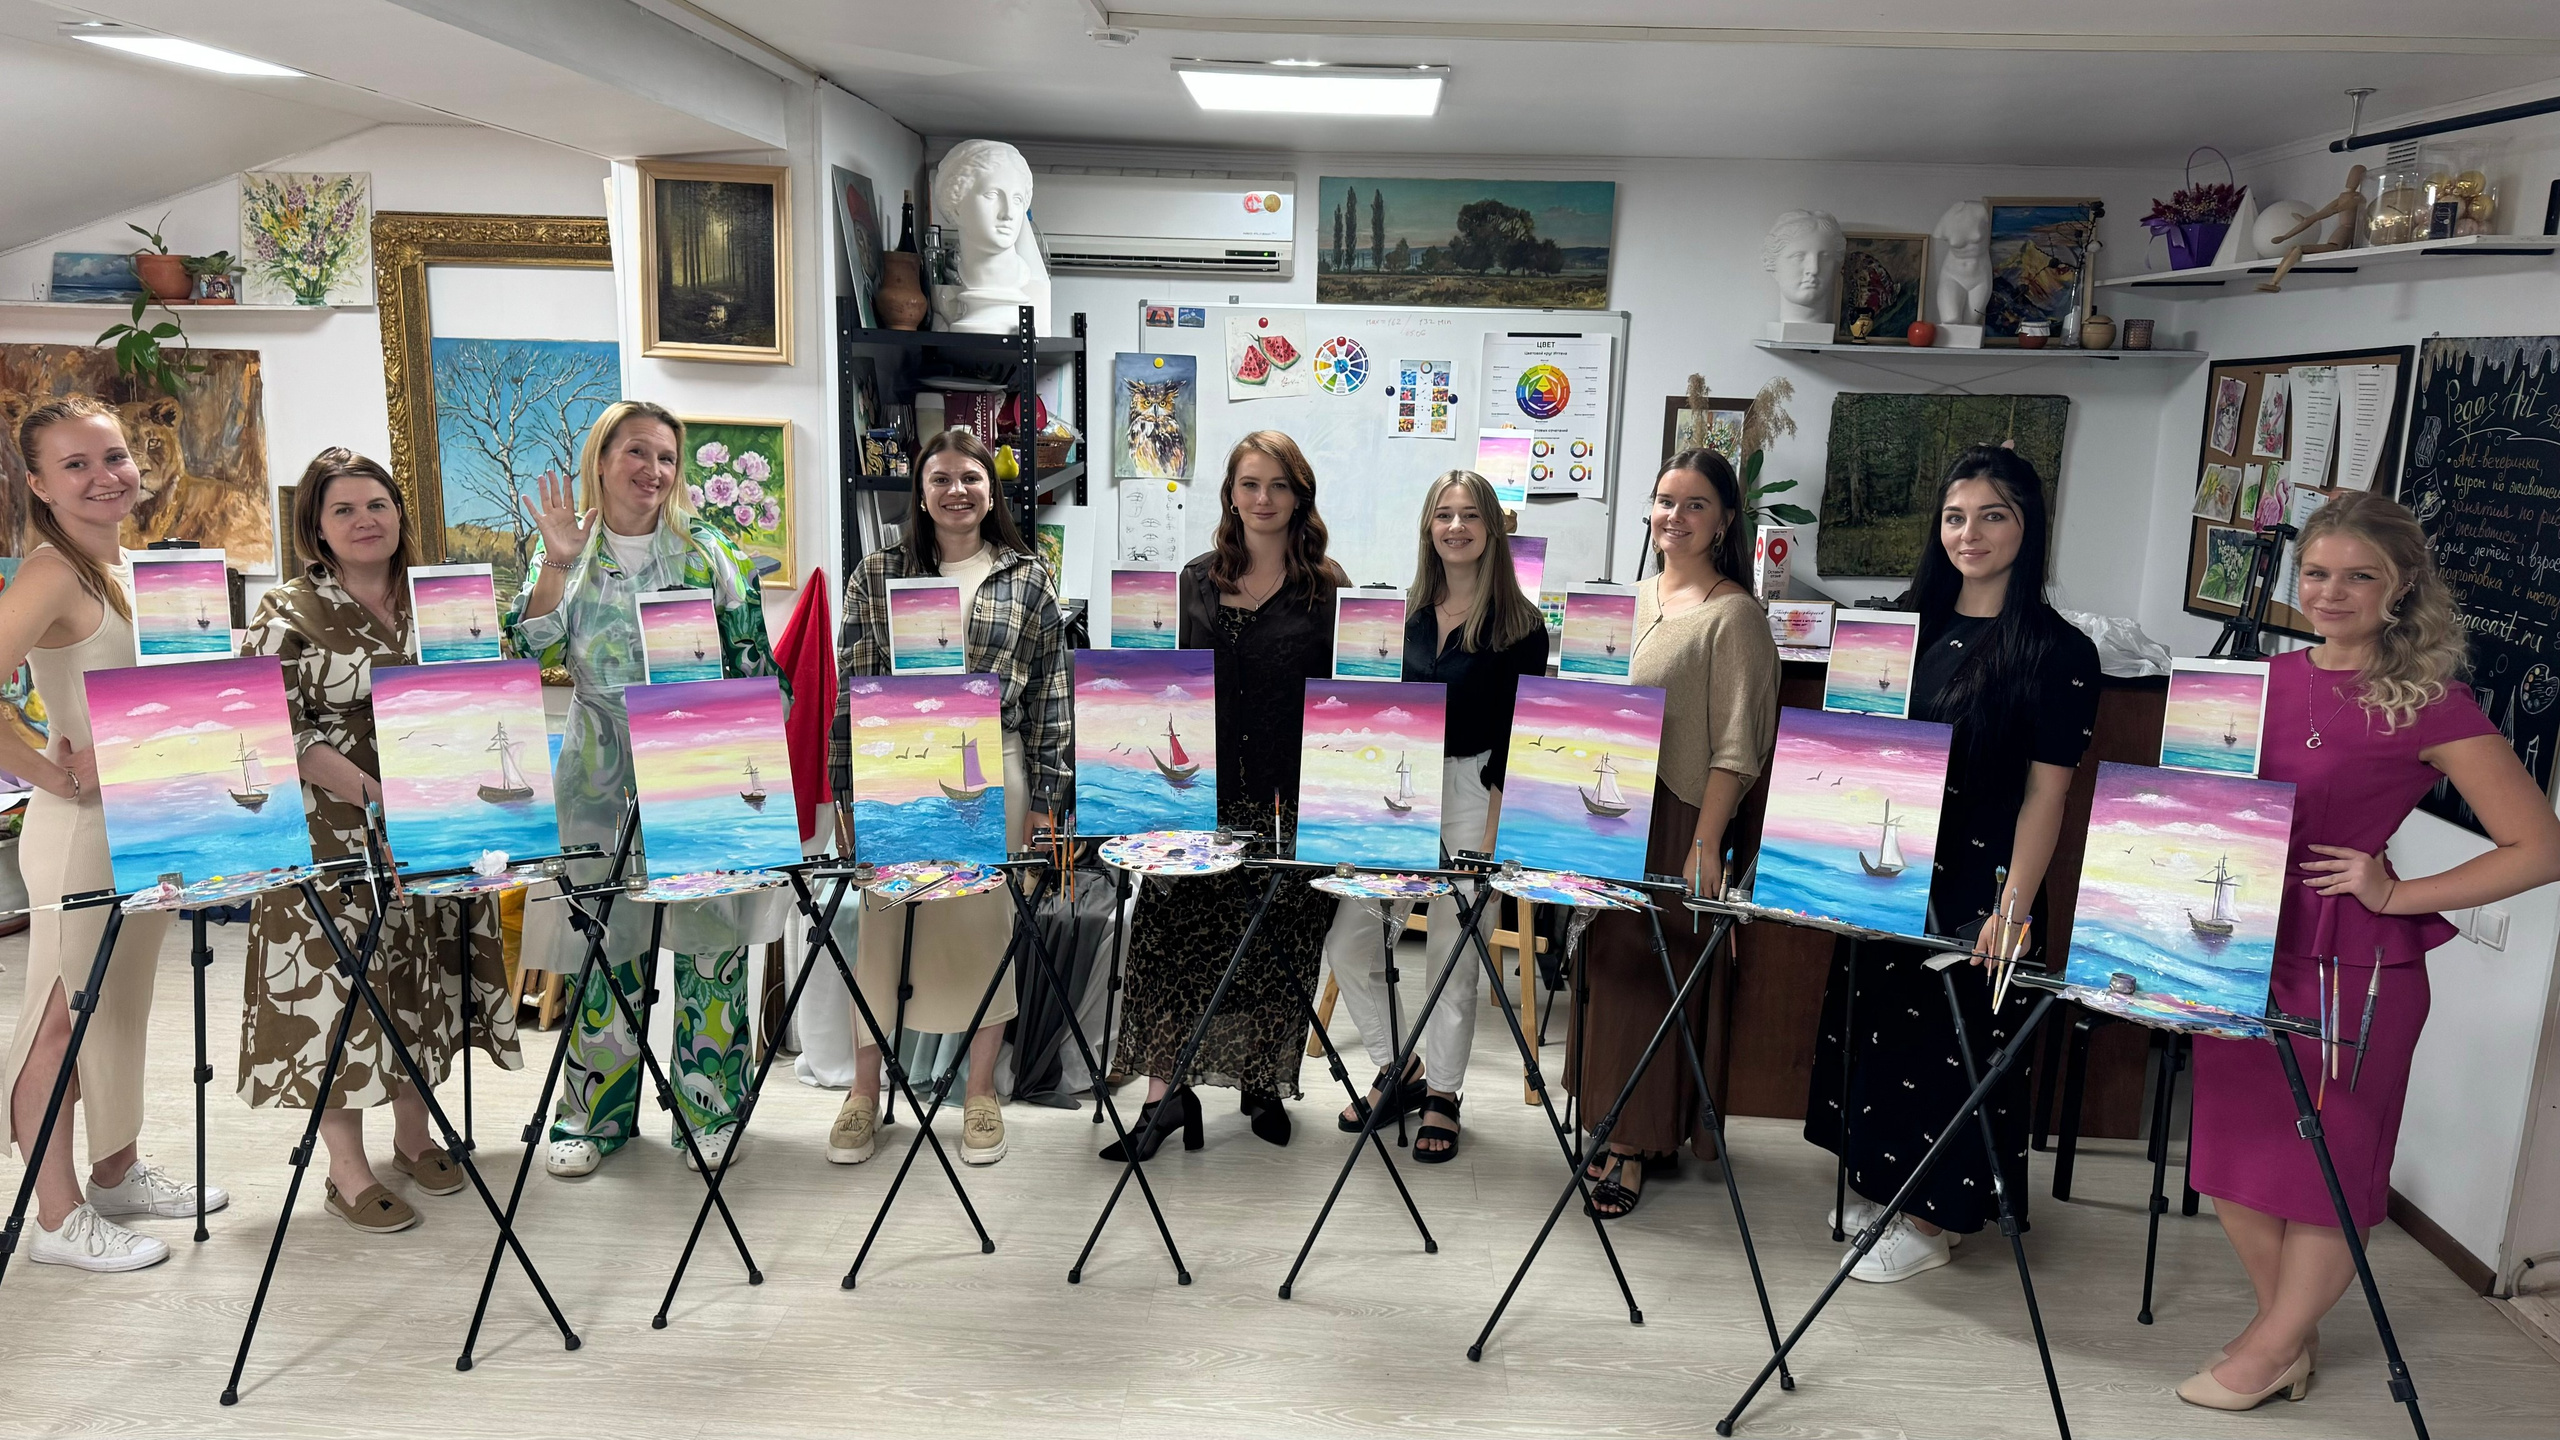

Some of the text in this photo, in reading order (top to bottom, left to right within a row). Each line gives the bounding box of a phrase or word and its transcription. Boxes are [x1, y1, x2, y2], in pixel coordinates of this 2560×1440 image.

[1536, 341, 1556, 349] ЦВЕТ
[2445, 378, 2499, 444] Pegas
[2502, 369, 2548, 421] Art
[2492, 480, 2505, 492] по
[2445, 499, 2560, 536] занятия по рис
[2438, 561, 2503, 590] подготовка
[2511, 584, 2521, 597] к
[2440, 541, 2560, 586] для детей и взрос
